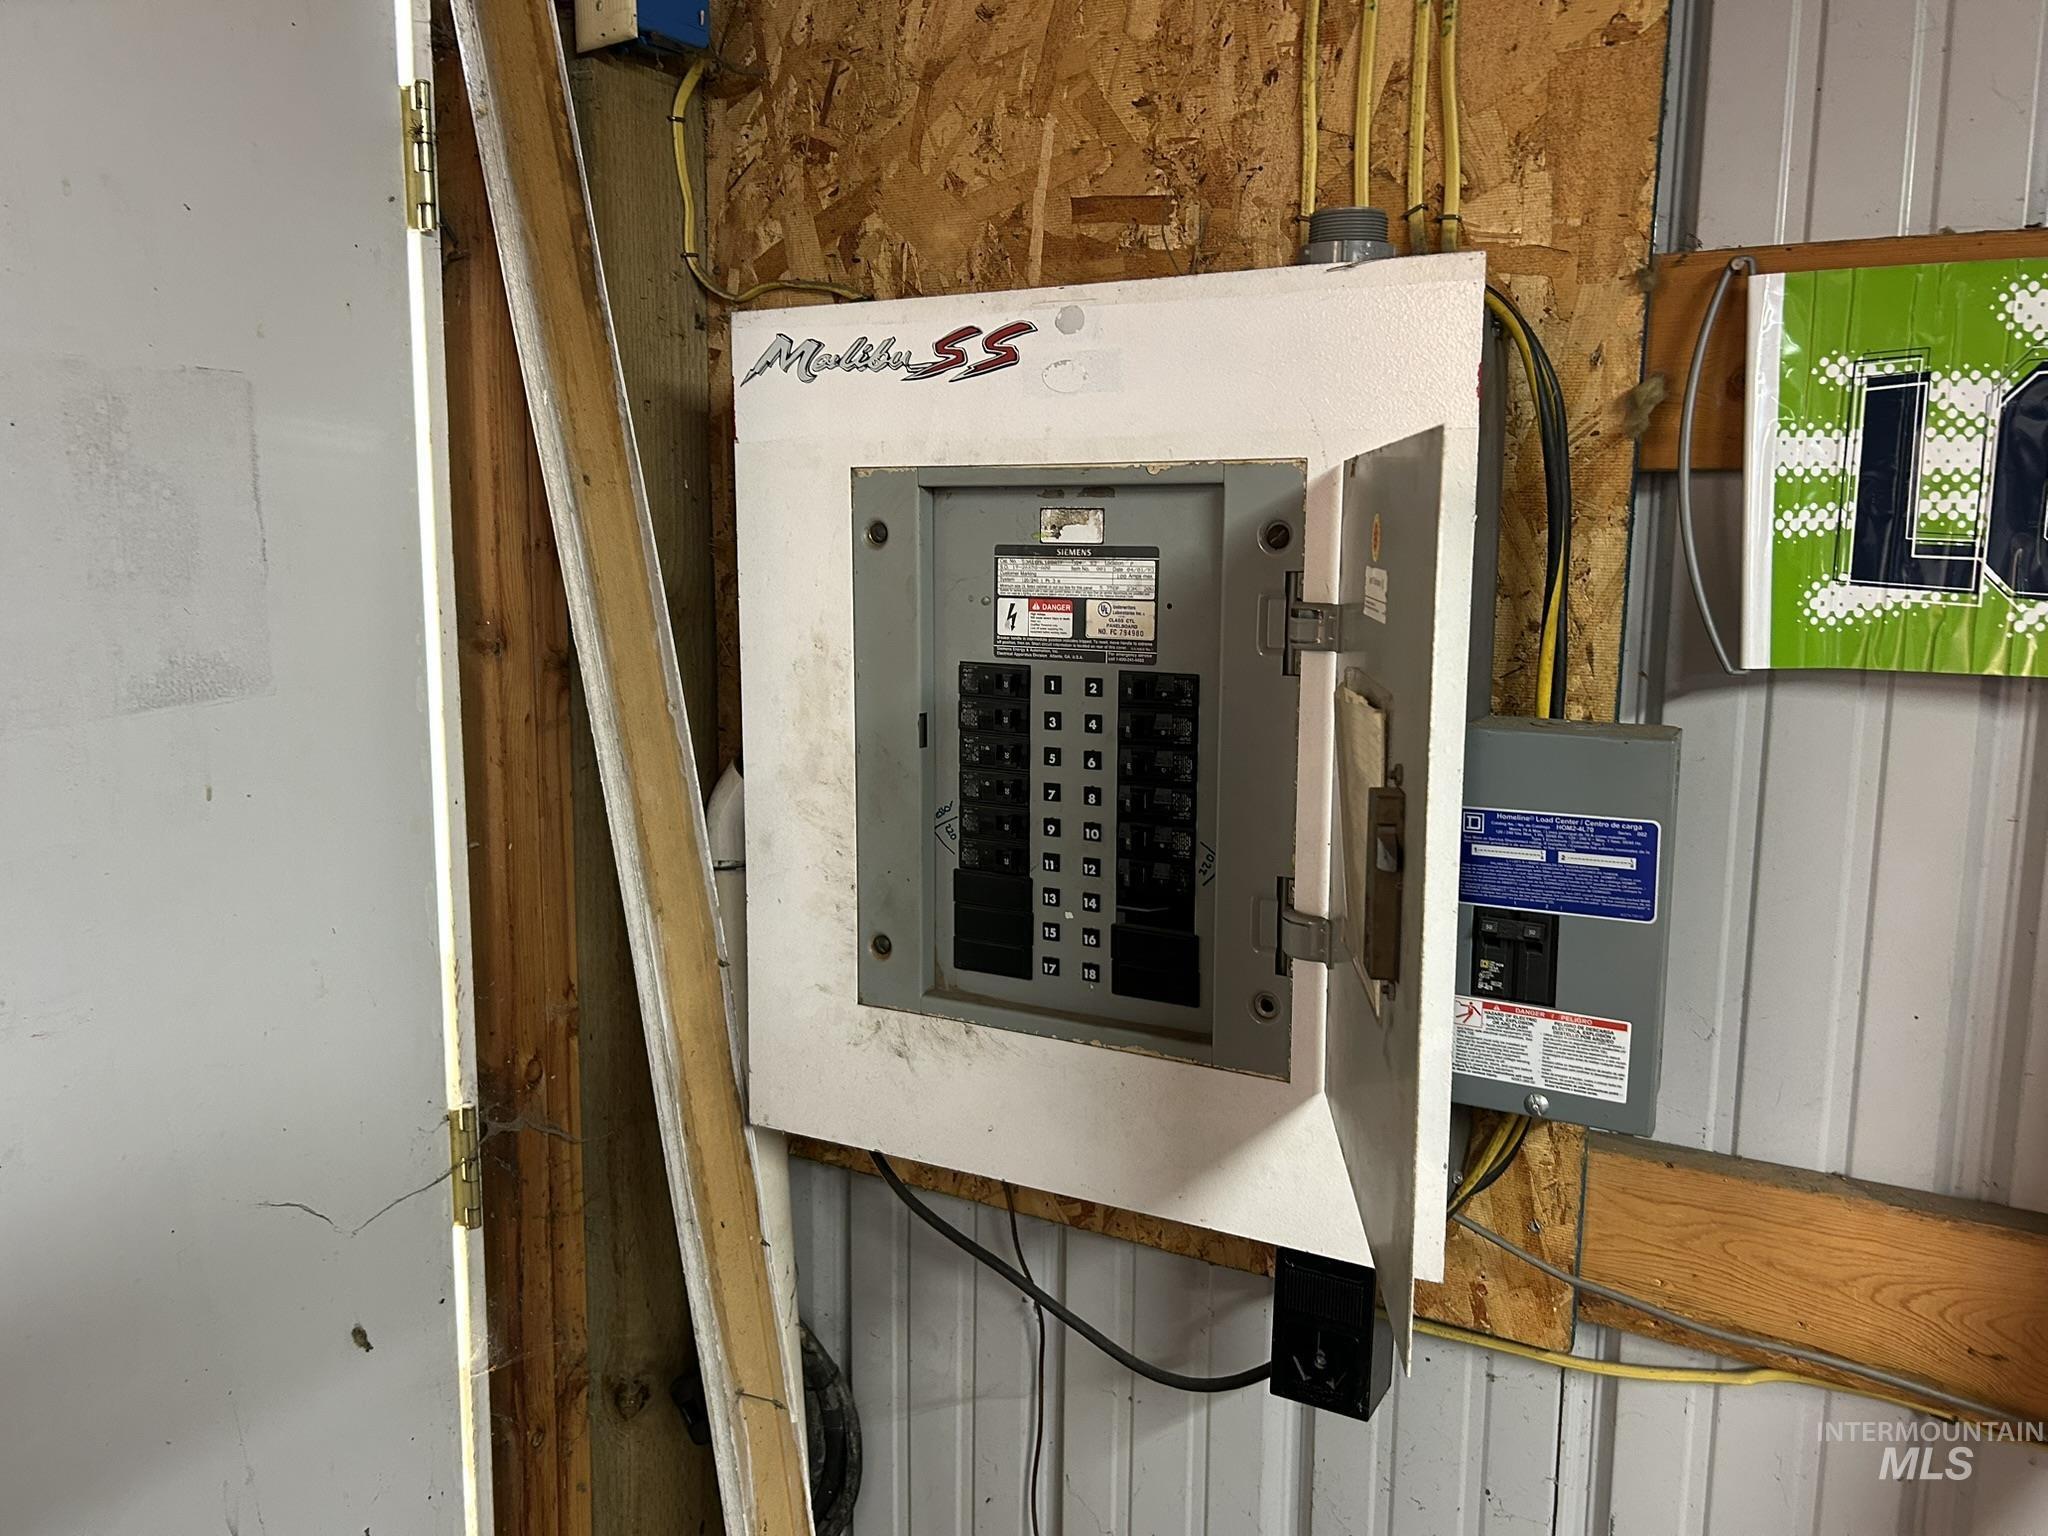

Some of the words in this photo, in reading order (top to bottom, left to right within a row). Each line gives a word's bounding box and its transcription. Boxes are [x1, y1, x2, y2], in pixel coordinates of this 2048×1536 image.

[740, 332, 912, 387] Malibu
[900, 320, 1038, 382] SS
[1056, 548, 1092, 556] SIEMENS
[1042, 603, 1071, 611] DANGER
[1050, 680, 1055, 691] 1
[1089, 683, 1097, 693] 2
[1049, 717, 1056, 727] 3
[1089, 719, 1096, 730] 4
[1049, 753, 1055, 764] 5
[1088, 757, 1096, 768] 6
[1048, 789, 1056, 800] 7
[1088, 794, 1096, 804] 8
[1536, 816, 1553, 824] Load
[1584, 820, 1609, 828] Centro
[945, 823, 957, 840] 220
[1047, 824, 1055, 835] 9
[1085, 829, 1099, 839] 10
[1044, 859, 1054, 870] 11
[1083, 864, 1096, 875] 12
[1044, 893, 1056, 904] 13
[1083, 898, 1096, 909] 14
[1044, 927, 1056, 938] 15
[1083, 934, 1096, 945] 16
[1044, 963, 1056, 974] 17
[1084, 968, 1096, 980] 18
[1515, 1008, 1545, 1018] DANGER
[1560, 1015, 1593, 1025] PELIGRO
